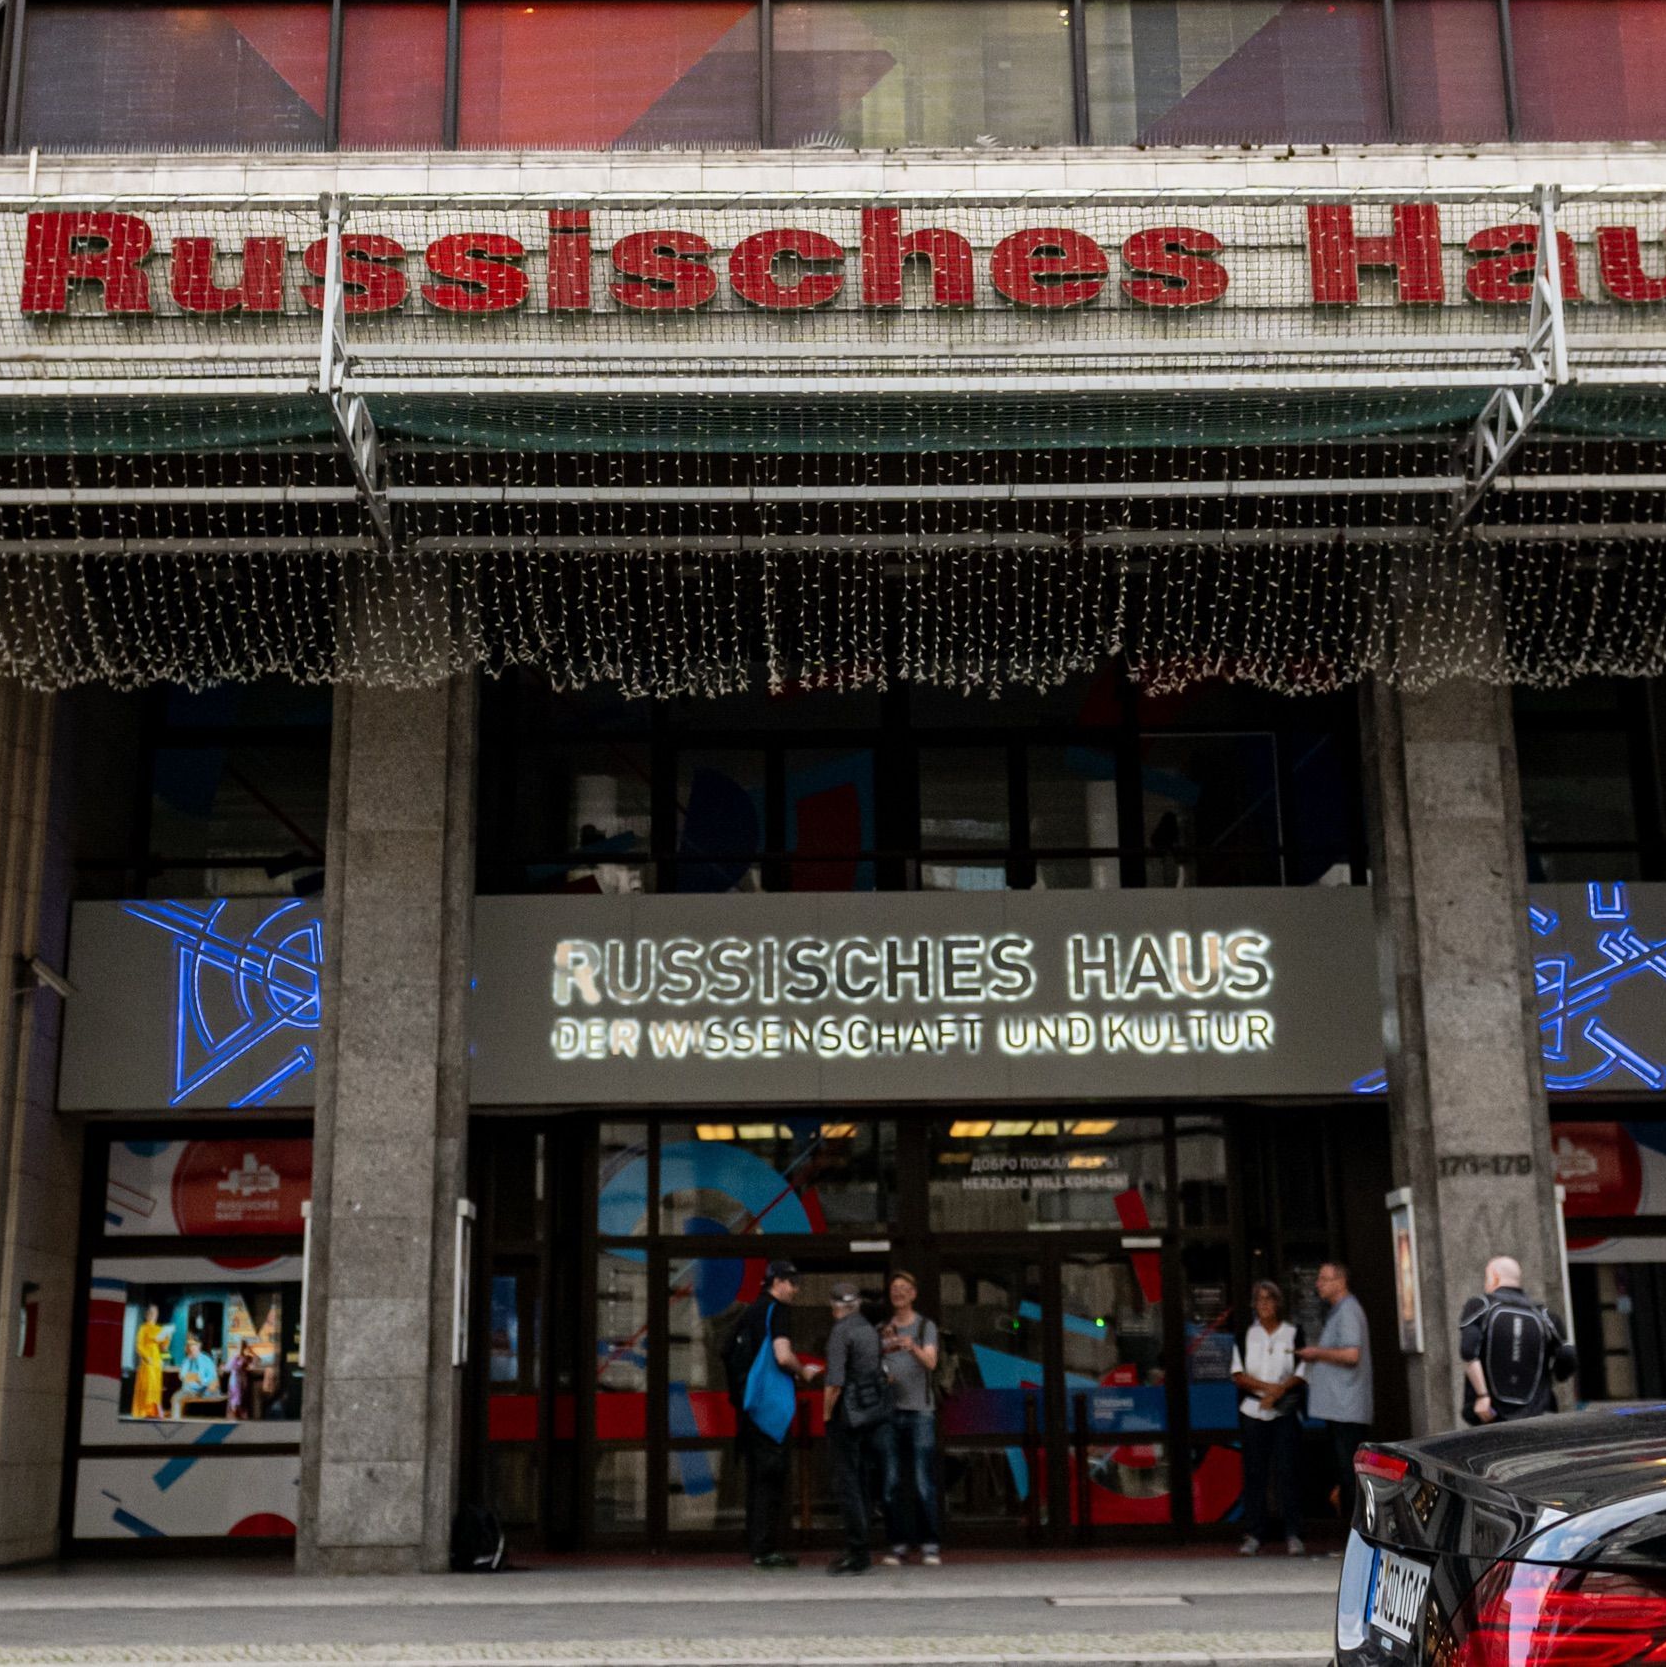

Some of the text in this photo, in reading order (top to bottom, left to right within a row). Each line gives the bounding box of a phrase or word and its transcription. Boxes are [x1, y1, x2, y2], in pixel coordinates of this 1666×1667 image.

[21, 205, 1229, 315] Russisches
[553, 931, 1273, 1005] RUSSISCHES HAUS
[552, 1006, 1274, 1060] DER WISSENSCHAFT UND KULTUR
[962, 1174, 1028, 1190] HERZLICH
[971, 1156, 1019, 1173] ДОБРО
